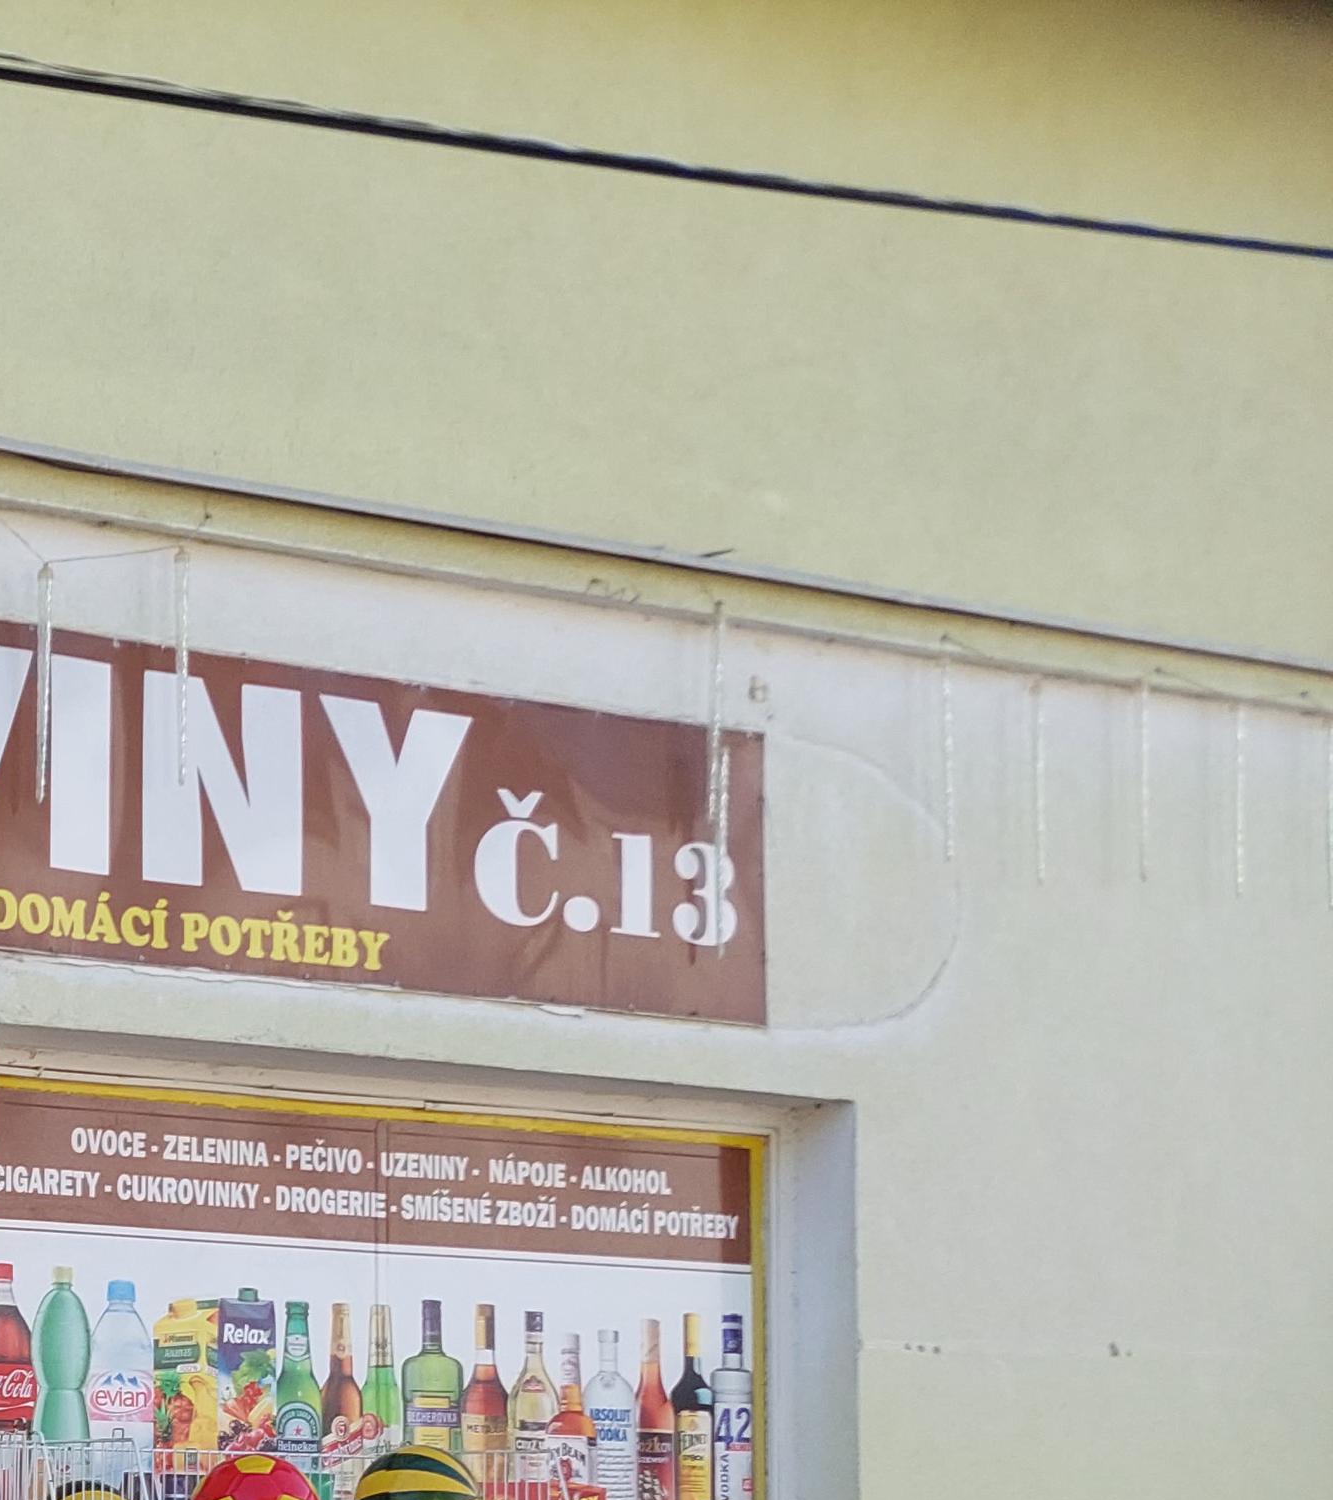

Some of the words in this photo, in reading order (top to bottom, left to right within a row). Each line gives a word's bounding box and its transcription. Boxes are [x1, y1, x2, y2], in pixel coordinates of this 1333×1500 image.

[473, 788, 737, 949] Č.13
[182, 906, 390, 972] POTŘEBY
[70, 1127, 147, 1158] OVOCE
[163, 1134, 269, 1168] ZELENINA
[285, 1139, 363, 1174] PEČIVO
[380, 1151, 470, 1181] UZENINY
[488, 1155, 566, 1189] NÁPOJE
[580, 1166, 672, 1195] ALKOHOL
[116, 1173, 259, 1209] CUKROVINKY
[275, 1185, 387, 1218] DROGERIE
[401, 1188, 492, 1225] SMÍŠENÉ
[495, 1195, 557, 1229] ZBOŽÍ
[571, 1199, 650, 1234] DOMÁCÍ
[653, 1207, 739, 1240] POTŘEBY
[223, 1323, 270, 1345] Relax
[95, 1387, 147, 1408] evian
[277, 1441, 318, 1452] Heineken
